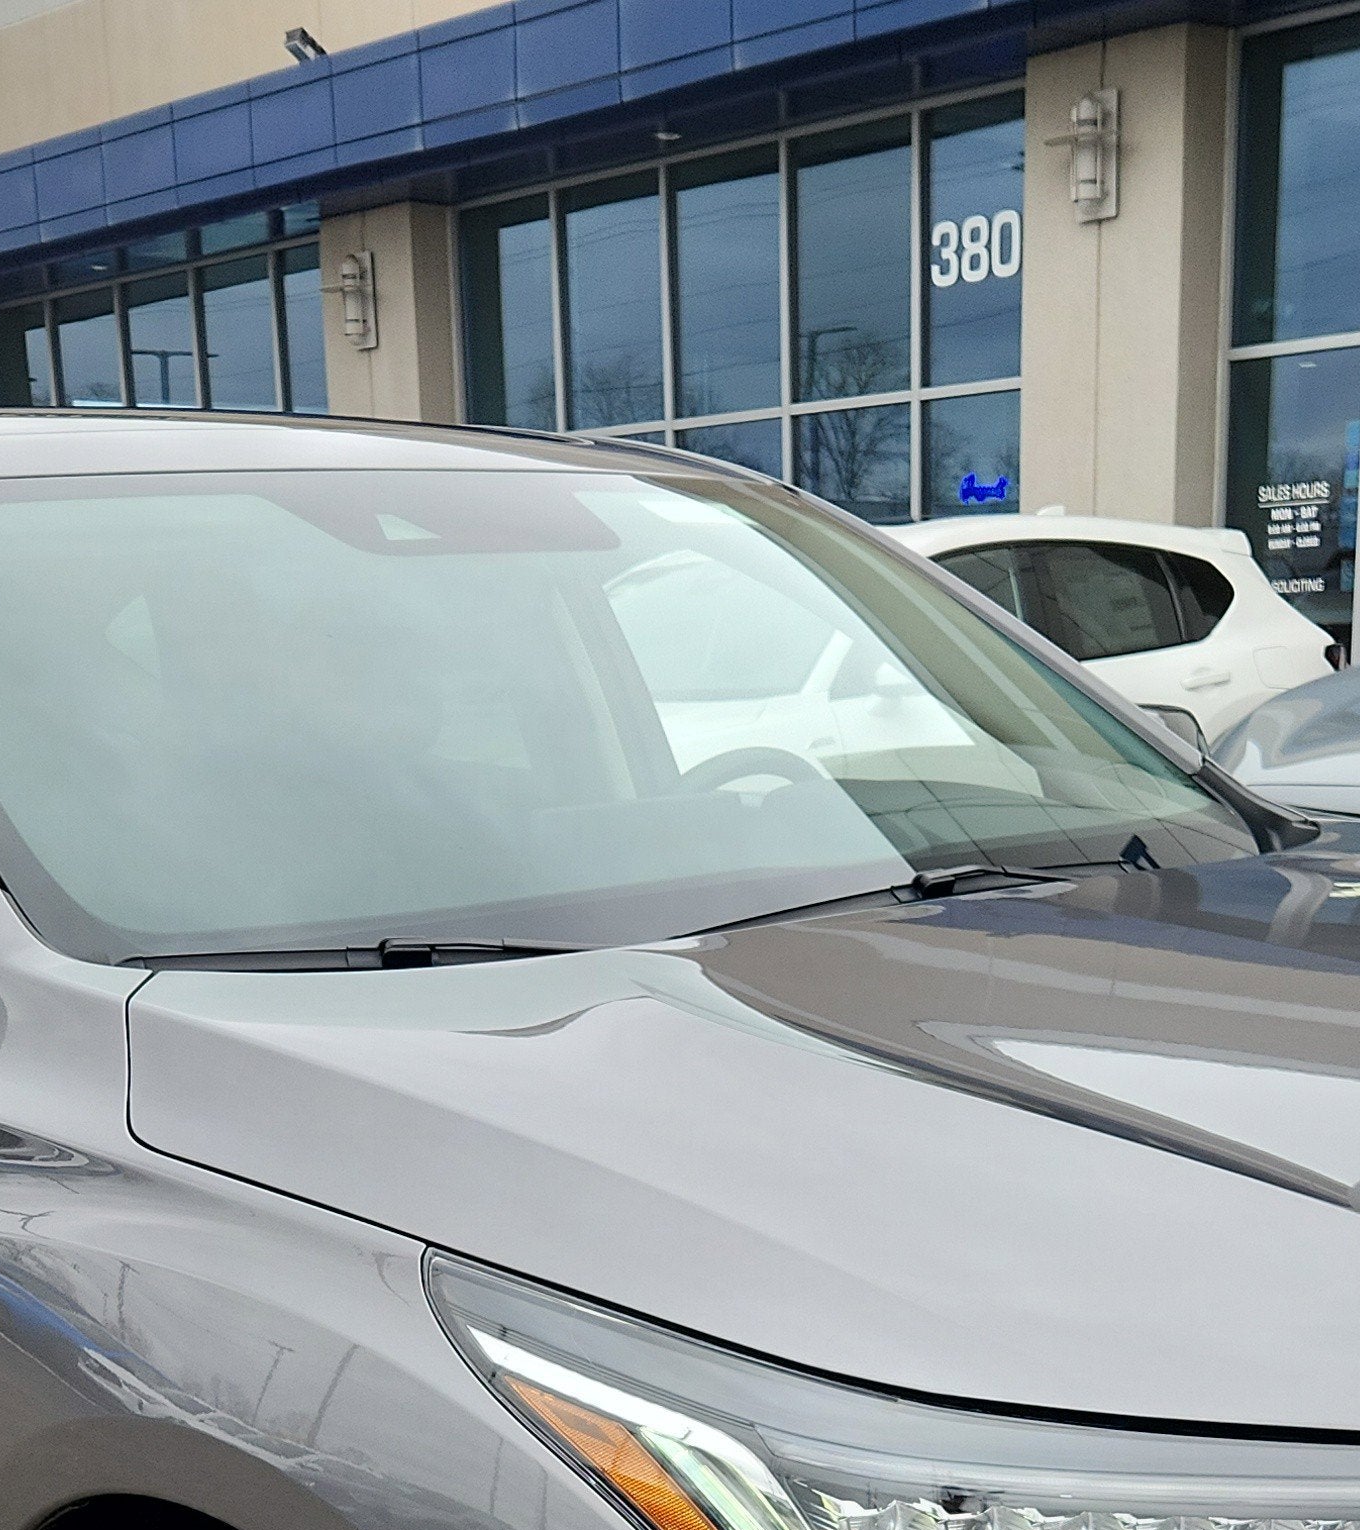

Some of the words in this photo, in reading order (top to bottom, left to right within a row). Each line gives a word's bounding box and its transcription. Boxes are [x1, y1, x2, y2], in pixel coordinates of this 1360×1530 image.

[931, 210, 1020, 287] 380
[1258, 484, 1291, 502] SALES
[1292, 480, 1331, 499] HOURS
[1271, 507, 1294, 521] MON
[1300, 505, 1319, 519] SAT
